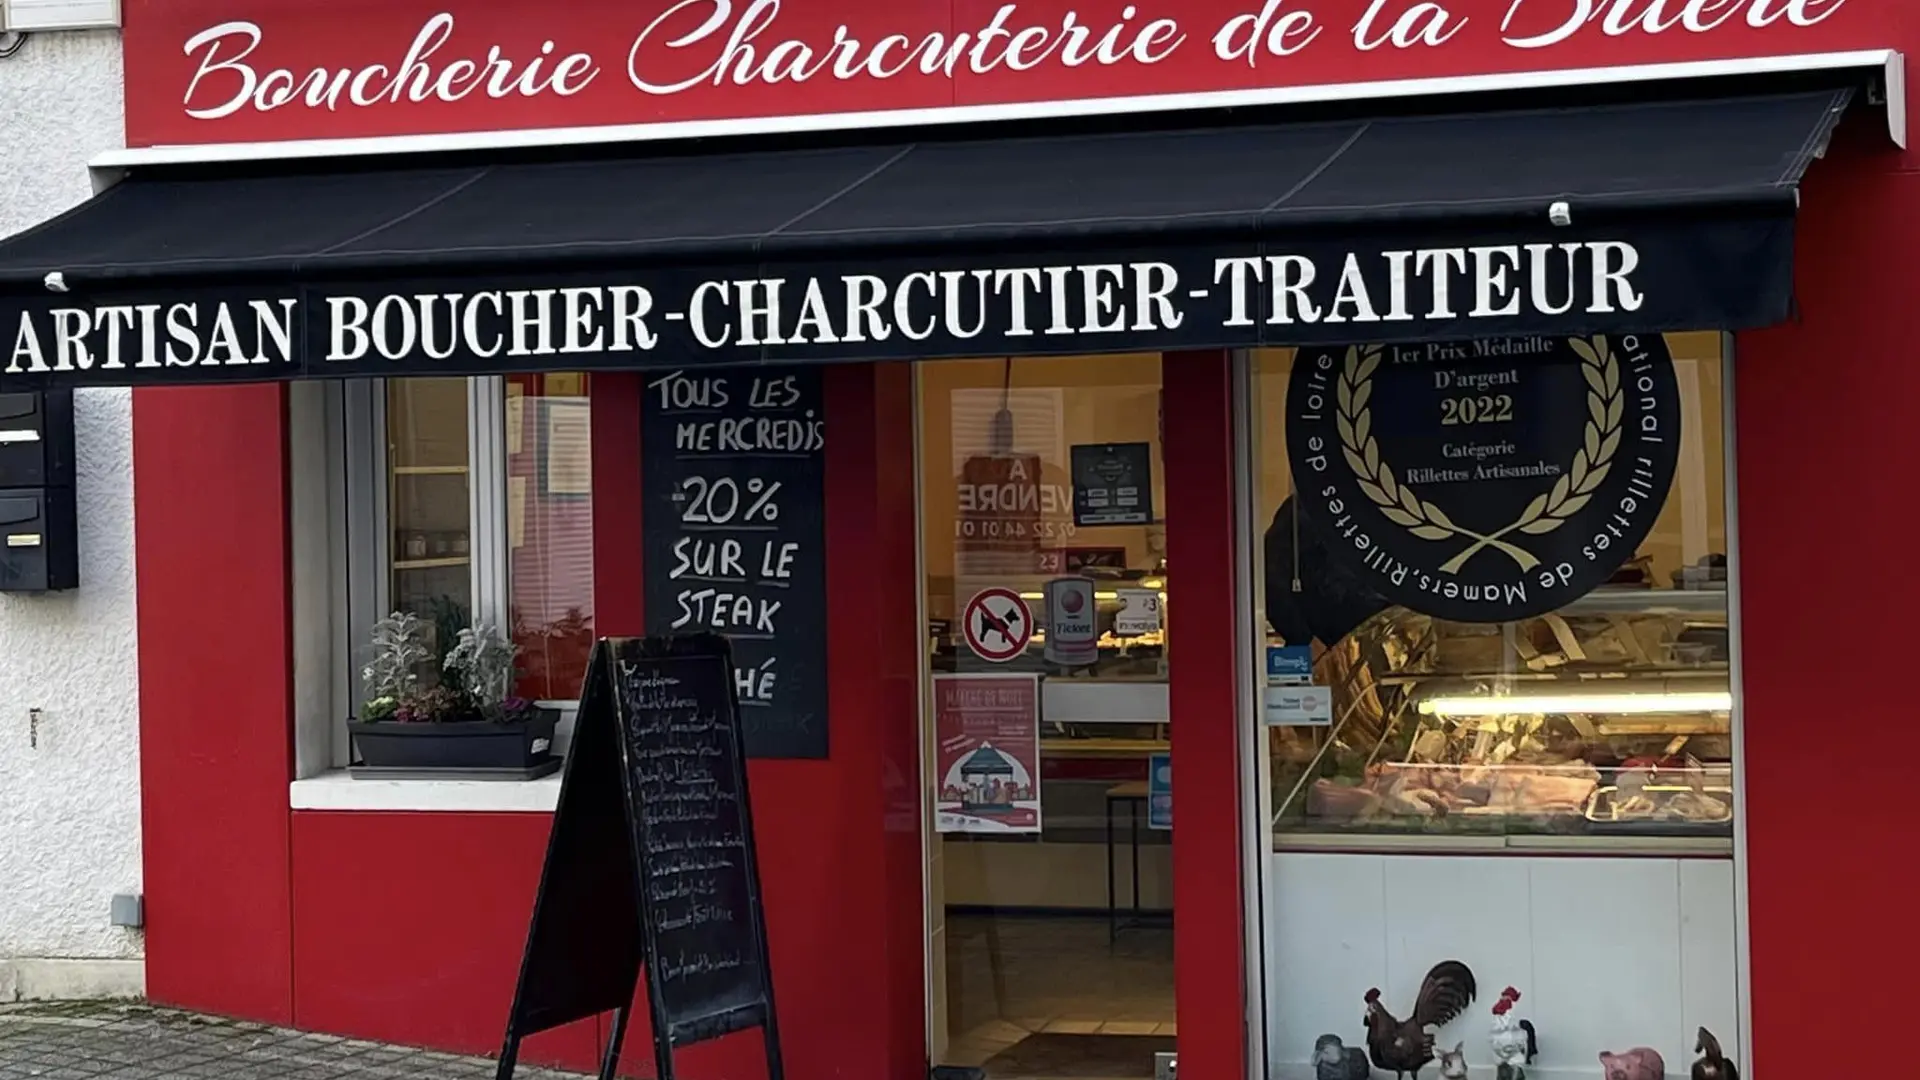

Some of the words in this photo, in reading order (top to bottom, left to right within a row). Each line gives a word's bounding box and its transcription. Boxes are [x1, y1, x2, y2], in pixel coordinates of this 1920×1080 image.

[184, 13, 599, 120] Boucherie
[627, 0, 1186, 96] Charcuterie
[1212, 0, 1336, 68] de
[1351, 0, 1465, 50] la
[5, 297, 297, 374] ARTISAN
[1427, 342, 1467, 361] Prix
[648, 370, 729, 409] TOUS
[748, 375, 800, 407] LES
[1301, 353, 1333, 420] loire
[1622, 335, 1663, 442] ational
[1440, 395, 1514, 425] 2022
[1305, 436, 1328, 472] de
[1442, 440, 1516, 461] Catégorie
[1407, 467, 1470, 484] Rillettes
[1473, 460, 1561, 480] Artisanales
[1582, 456, 1653, 562] rillettes
[669, 536, 746, 580] SUR
[761, 541, 799, 578] LE
[1539, 562, 1574, 588] de
[671, 588, 781, 633] STEAK
